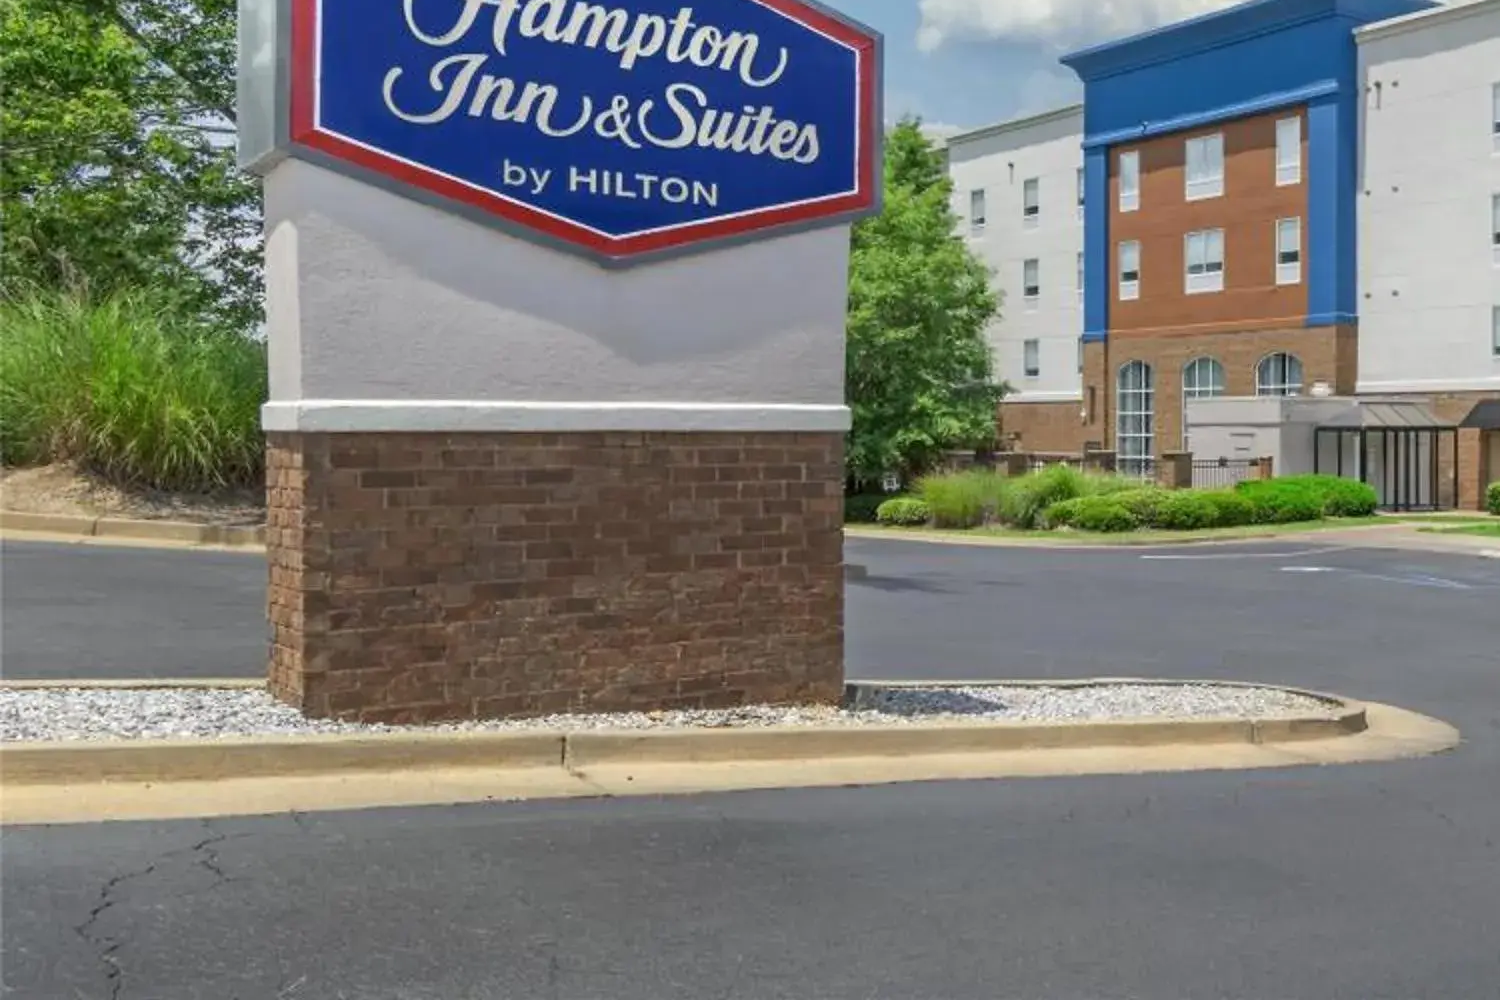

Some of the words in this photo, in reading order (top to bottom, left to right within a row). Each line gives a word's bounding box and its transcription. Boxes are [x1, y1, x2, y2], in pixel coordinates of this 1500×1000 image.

[382, 53, 593, 137] Inn
[594, 95, 642, 149] &
[637, 83, 819, 163] Suites
[503, 159, 551, 194] by
[569, 167, 718, 207] HILTON
